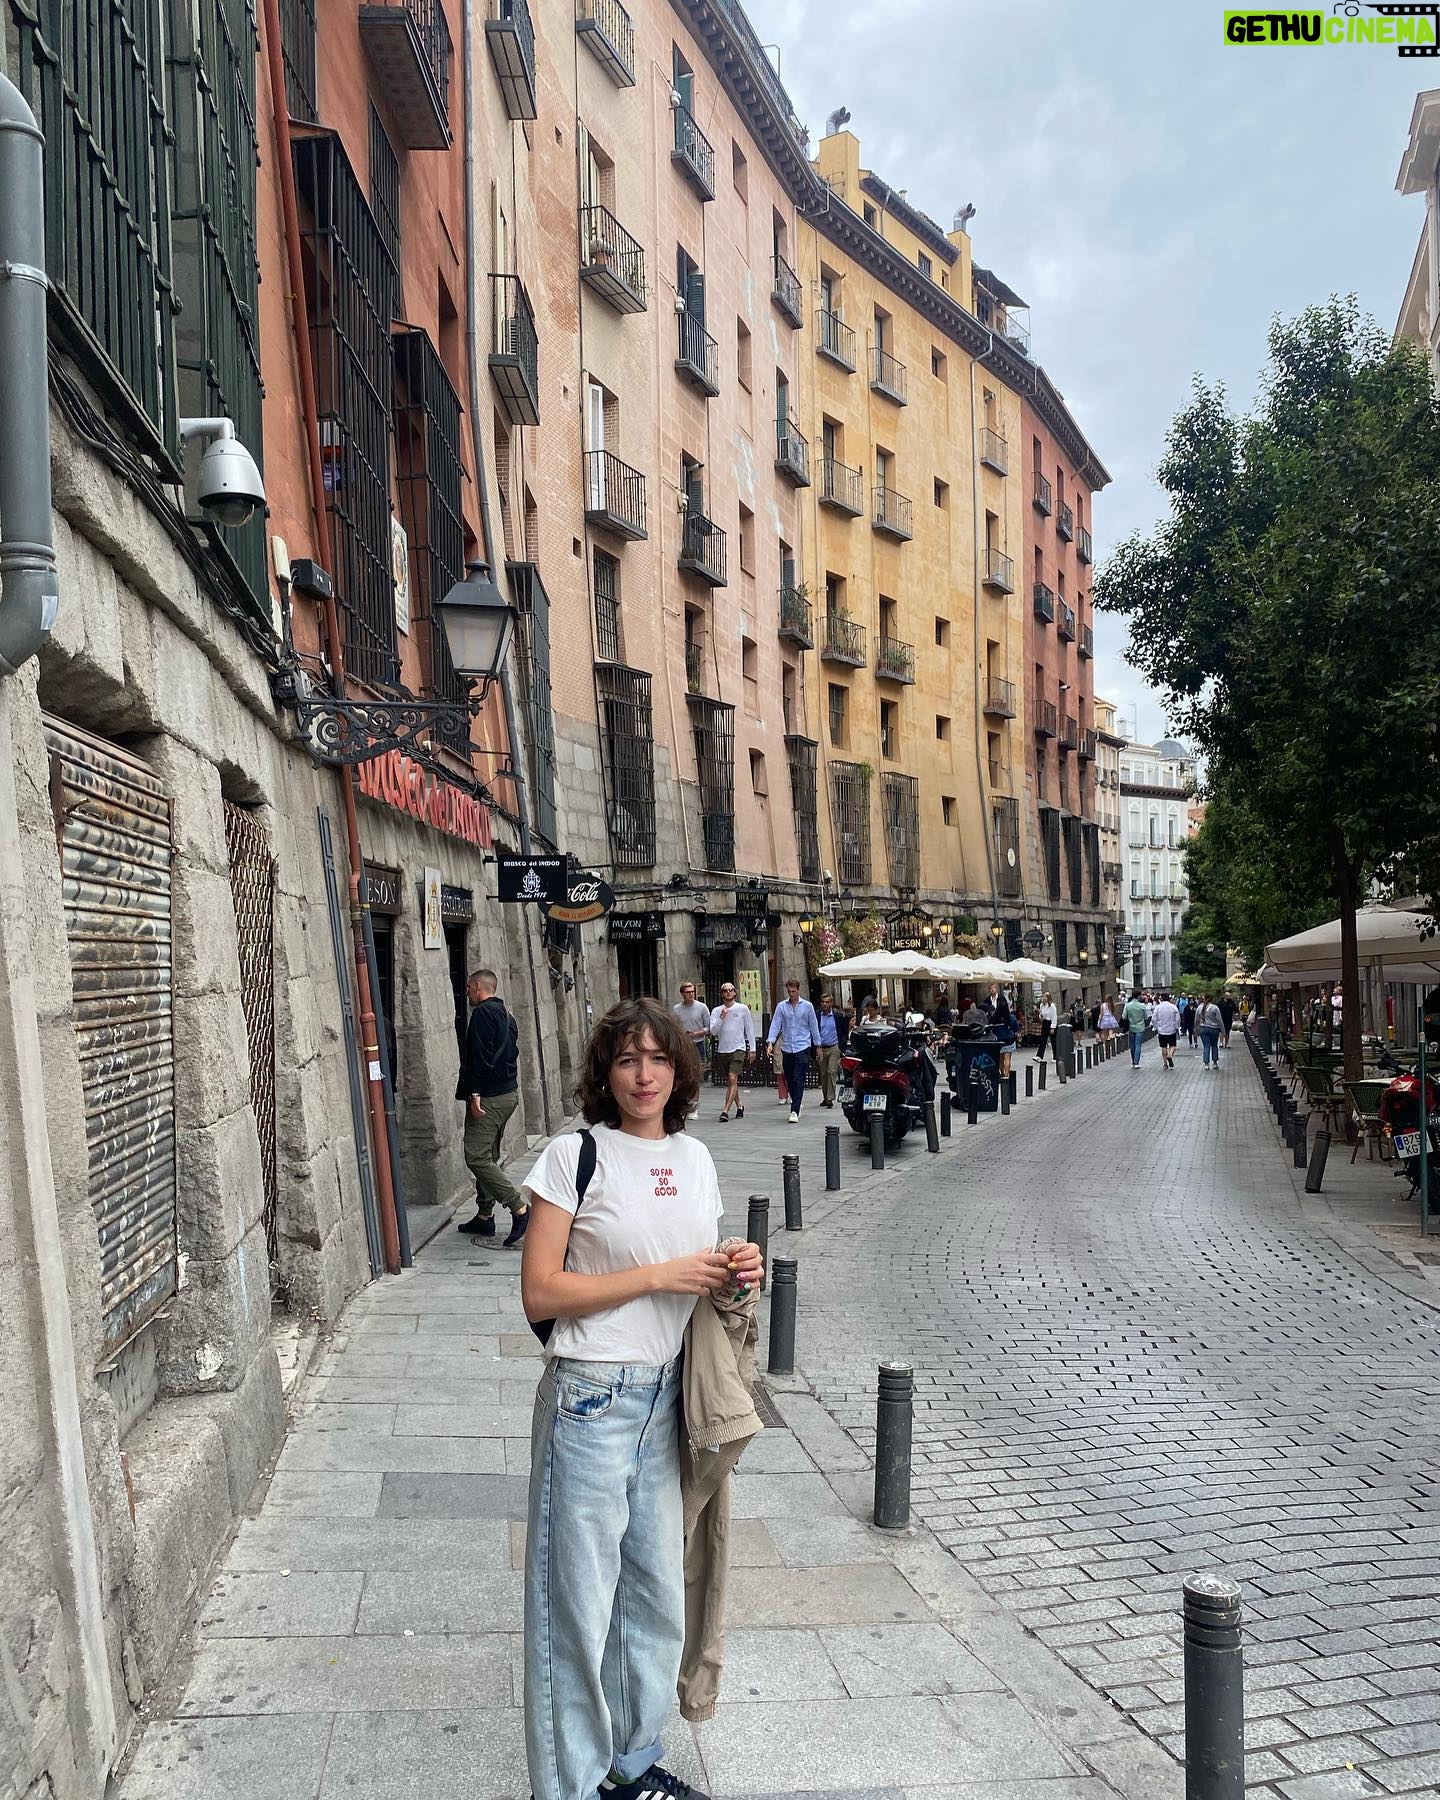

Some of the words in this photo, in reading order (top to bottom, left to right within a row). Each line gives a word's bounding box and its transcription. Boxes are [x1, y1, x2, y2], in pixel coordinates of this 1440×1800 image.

[366, 877, 397, 905] ESON
[612, 919, 642, 929] MESON
[894, 939, 921, 949] MESON
[1403, 1133, 1420, 1146] 879
[1405, 1144, 1419, 1155] KG
[650, 1168, 660, 1176] SO
[660, 1168, 673, 1176] FAR
[658, 1177, 669, 1186] SO
[654, 1187, 677, 1196] GOOD
